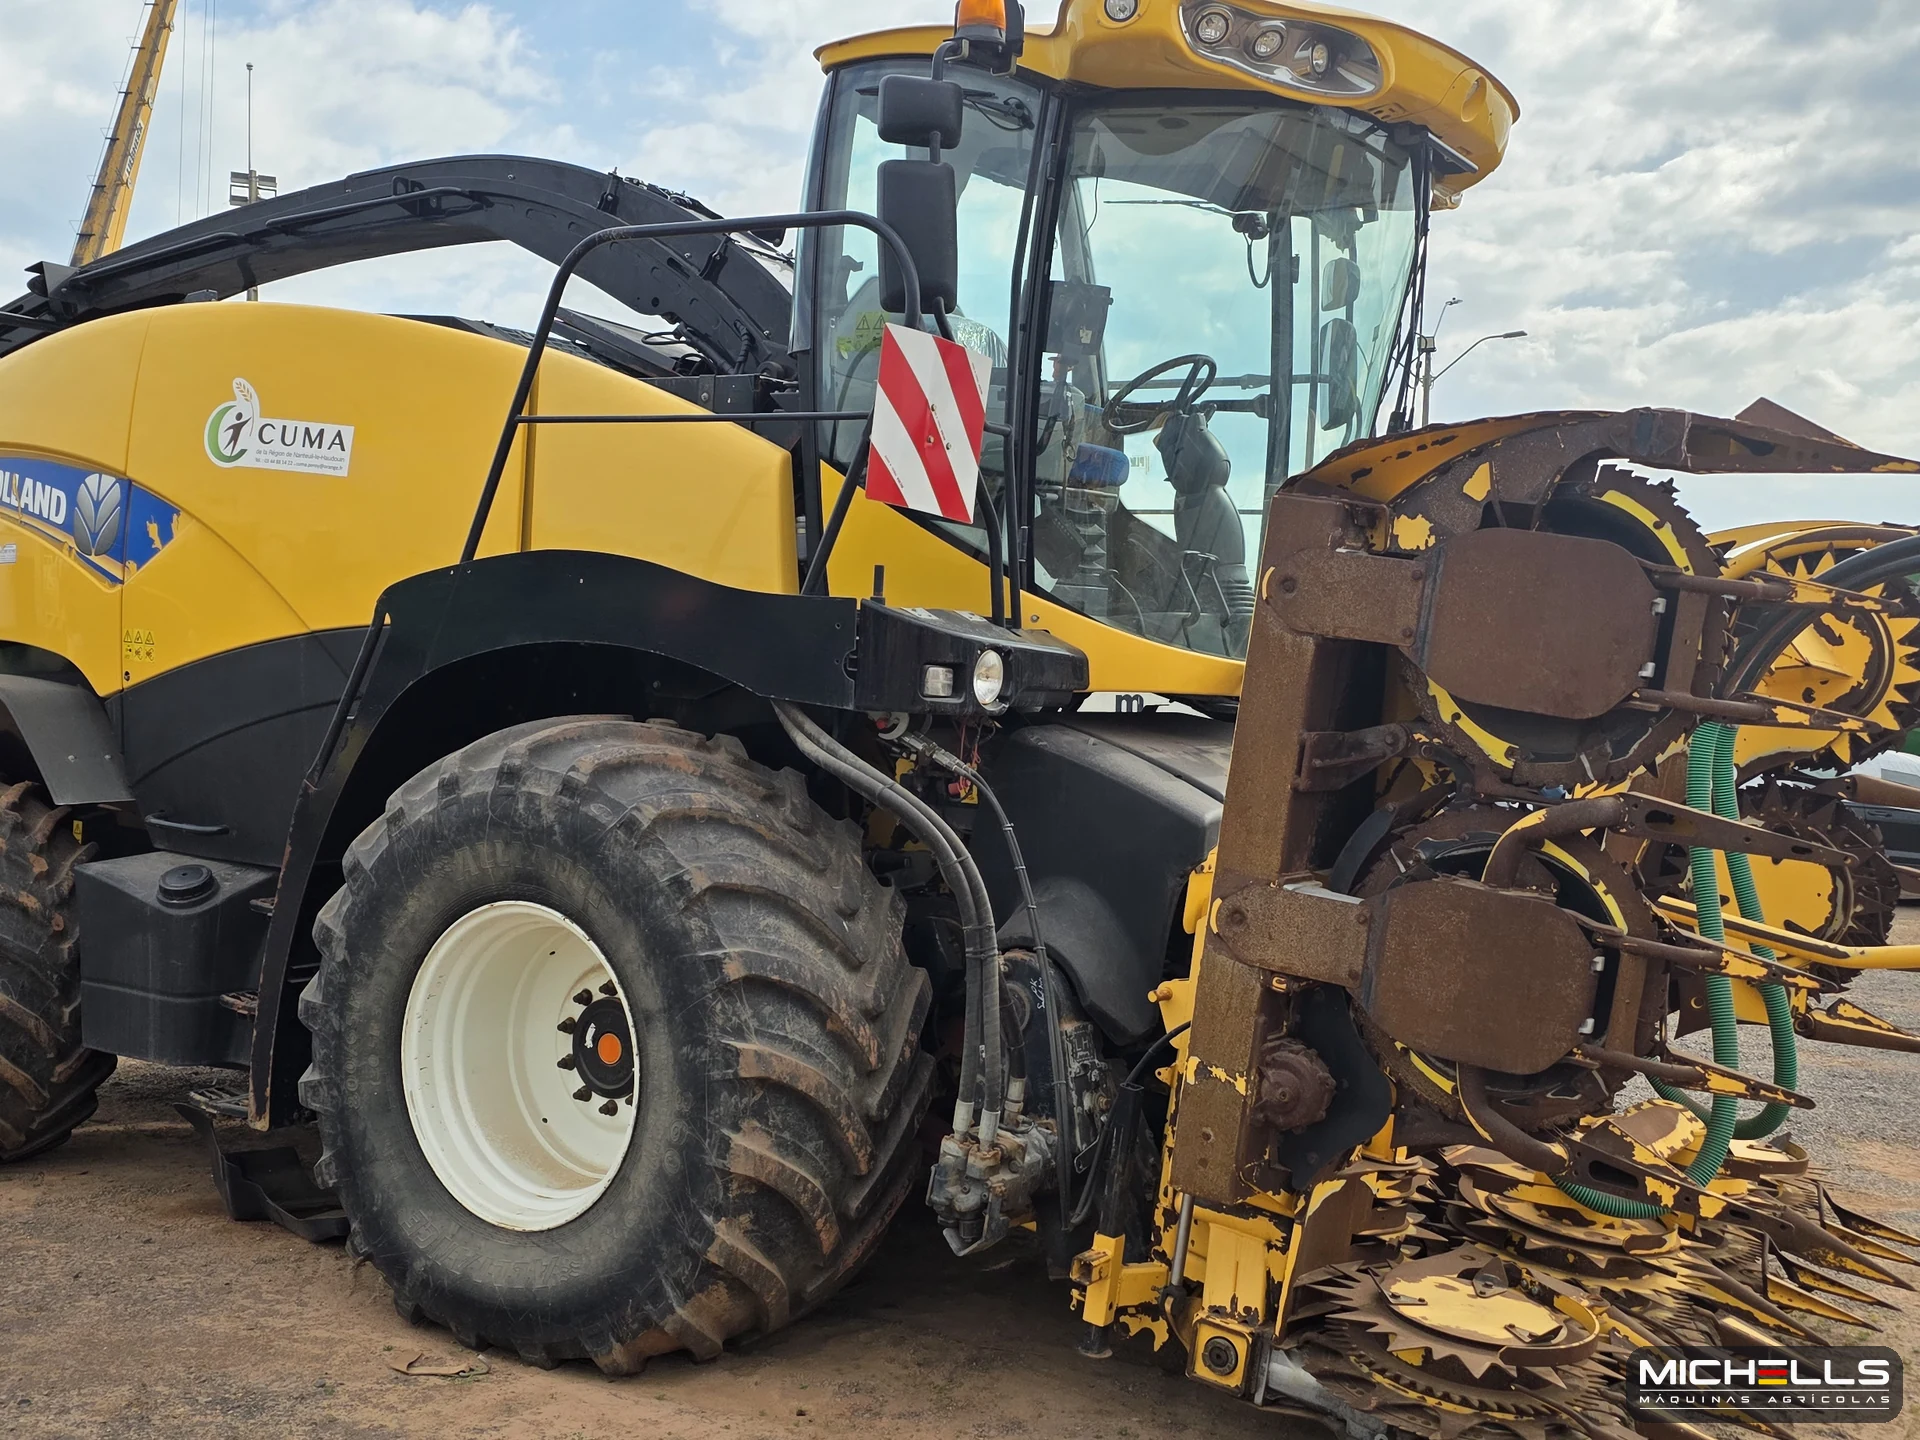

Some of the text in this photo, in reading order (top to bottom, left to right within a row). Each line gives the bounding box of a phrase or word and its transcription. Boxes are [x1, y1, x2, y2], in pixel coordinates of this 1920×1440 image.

[258, 423, 346, 451] CUMA
[268, 450, 285, 458] Région
[0, 469, 67, 525] LLAND
